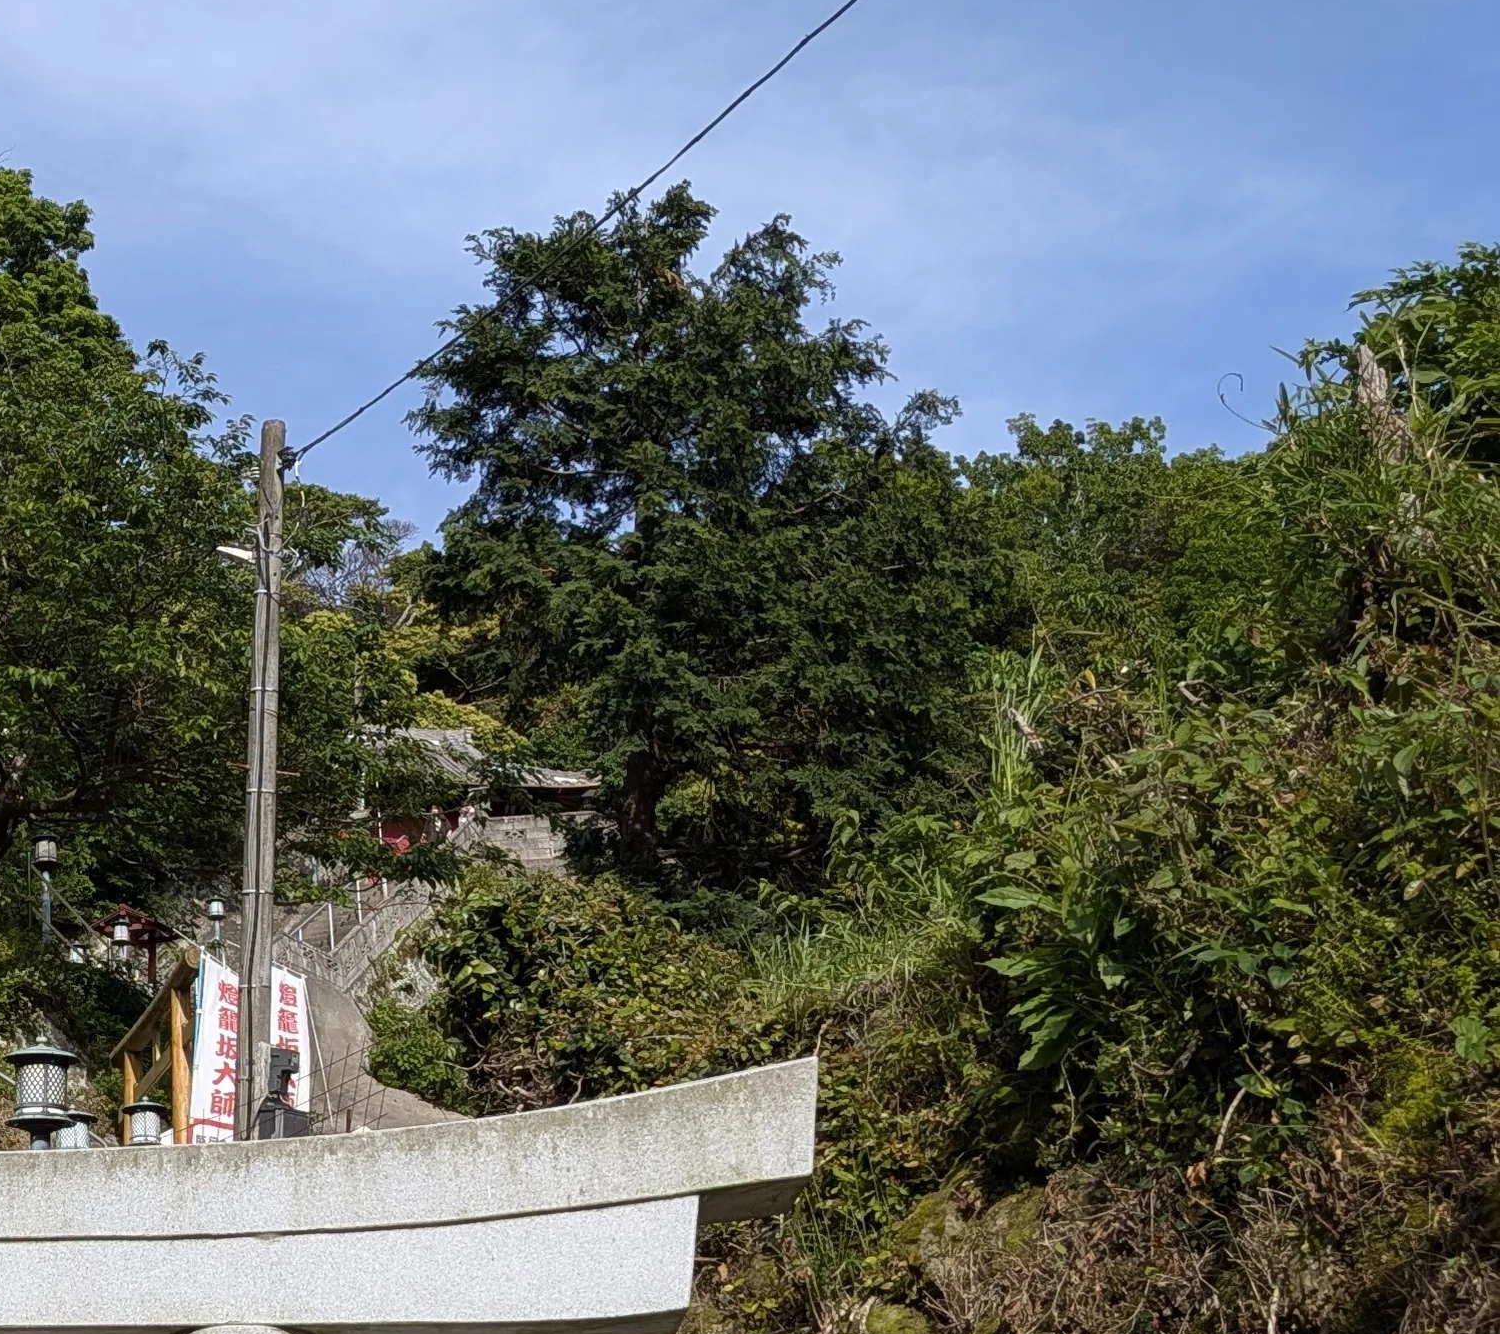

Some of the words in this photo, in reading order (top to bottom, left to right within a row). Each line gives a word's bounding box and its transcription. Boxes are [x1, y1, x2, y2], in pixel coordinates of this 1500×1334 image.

[210, 979, 238, 1117] 燈籠坂大師
[276, 981, 299, 1109] 燈籠坂
